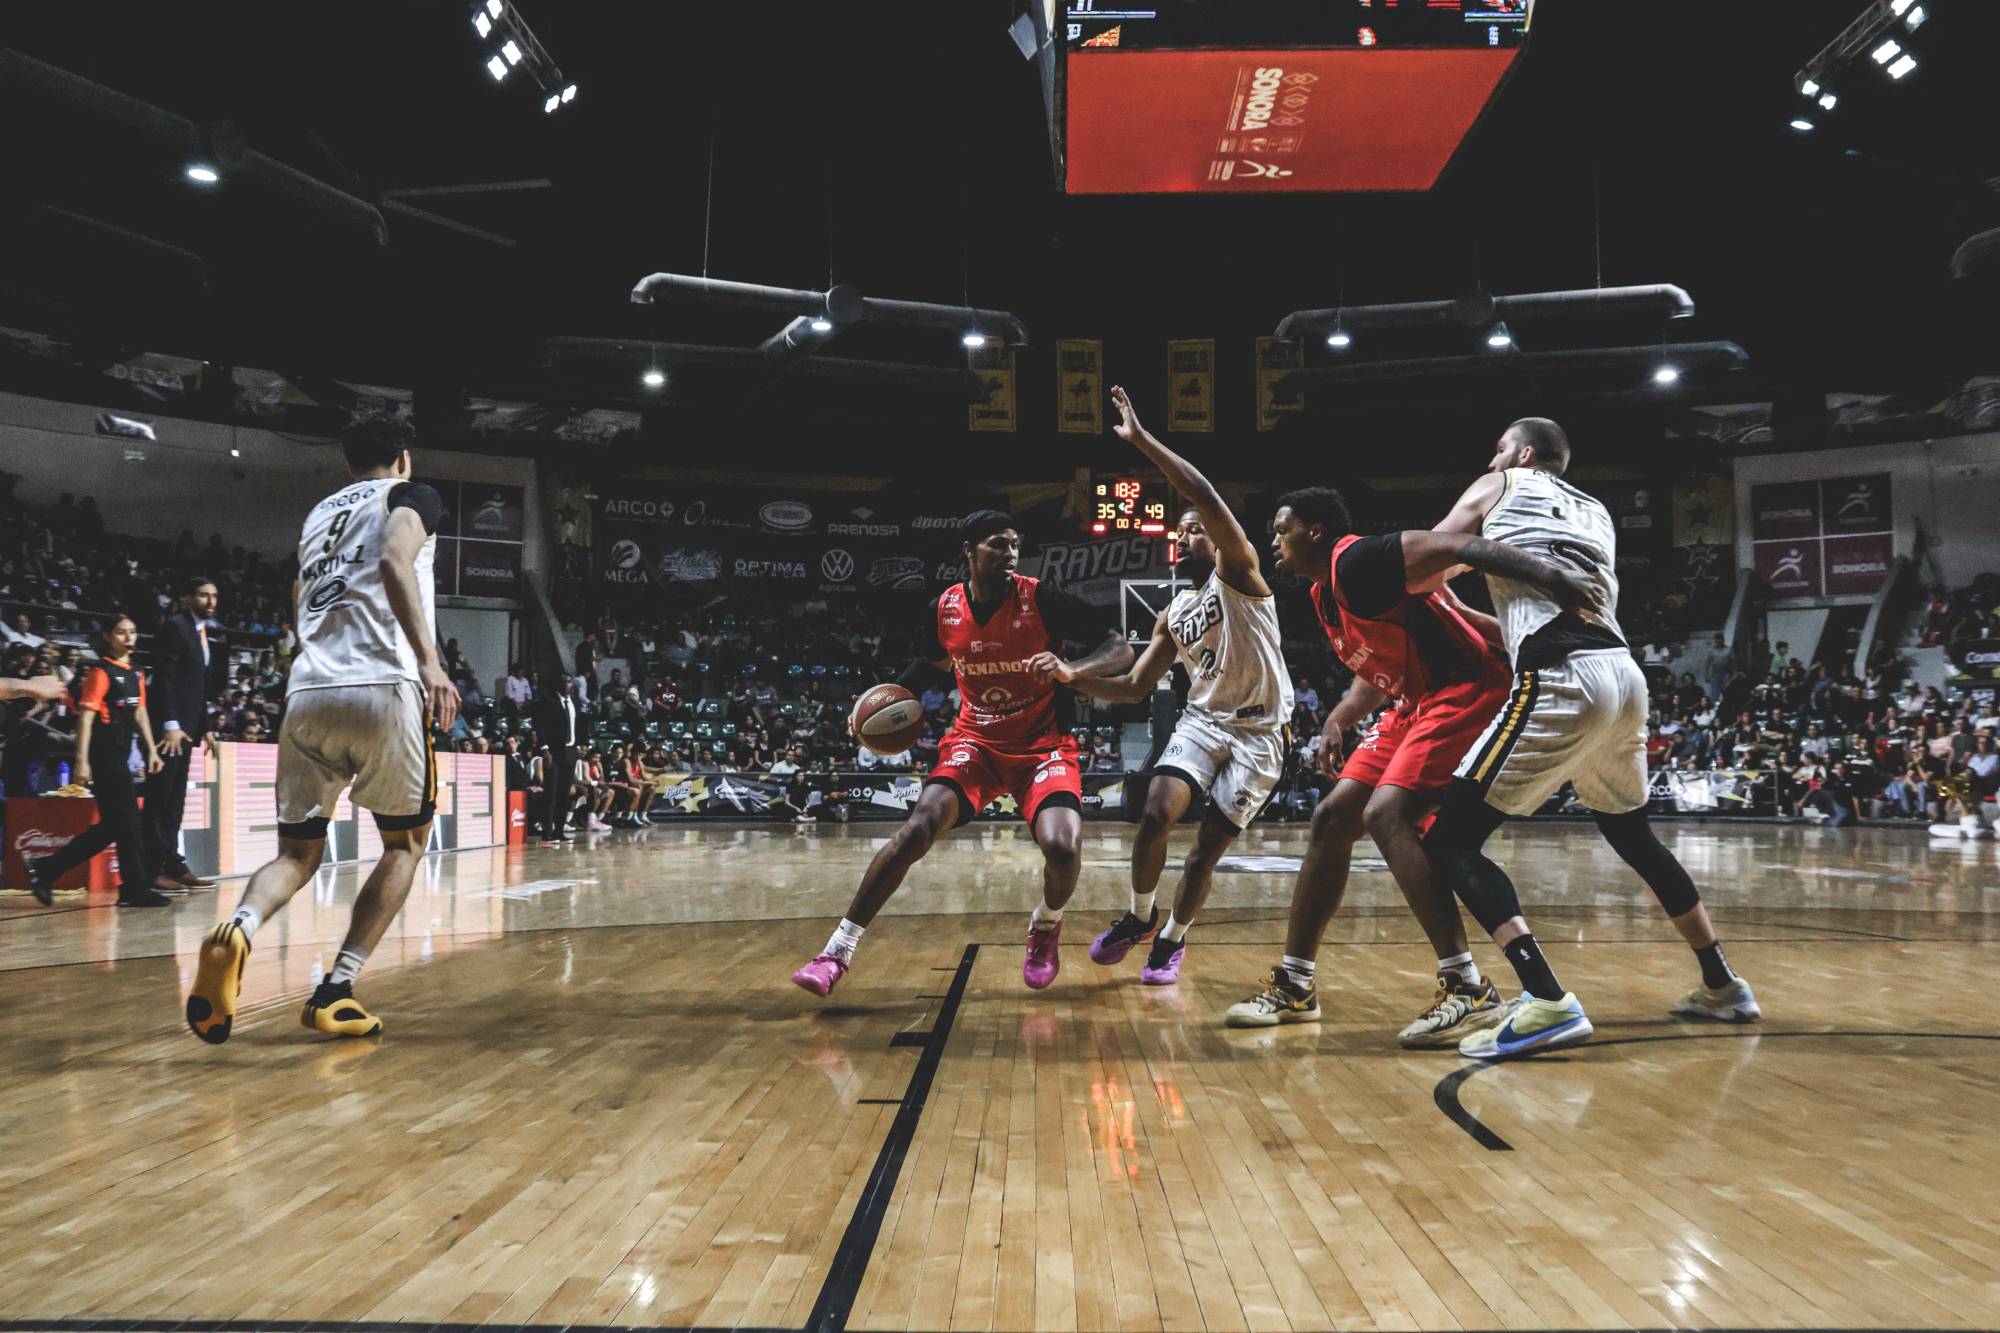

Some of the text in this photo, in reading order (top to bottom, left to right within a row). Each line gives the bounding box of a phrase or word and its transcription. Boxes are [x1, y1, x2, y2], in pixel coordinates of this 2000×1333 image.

[1241, 67, 1284, 131] SONORA
[605, 499, 656, 516] ARCO
[1098, 503, 1115, 519] 35
[1124, 498, 1134, 514] 2
[1145, 503, 1164, 519] 49
[323, 509, 352, 554] 9
[828, 524, 900, 537] PRENOSA
[465, 566, 514, 578] SONORA
[734, 560, 808, 577] OPTIMA
[1040, 535, 1149, 594] RAYOS
[604, 569, 648, 584] MEGA
